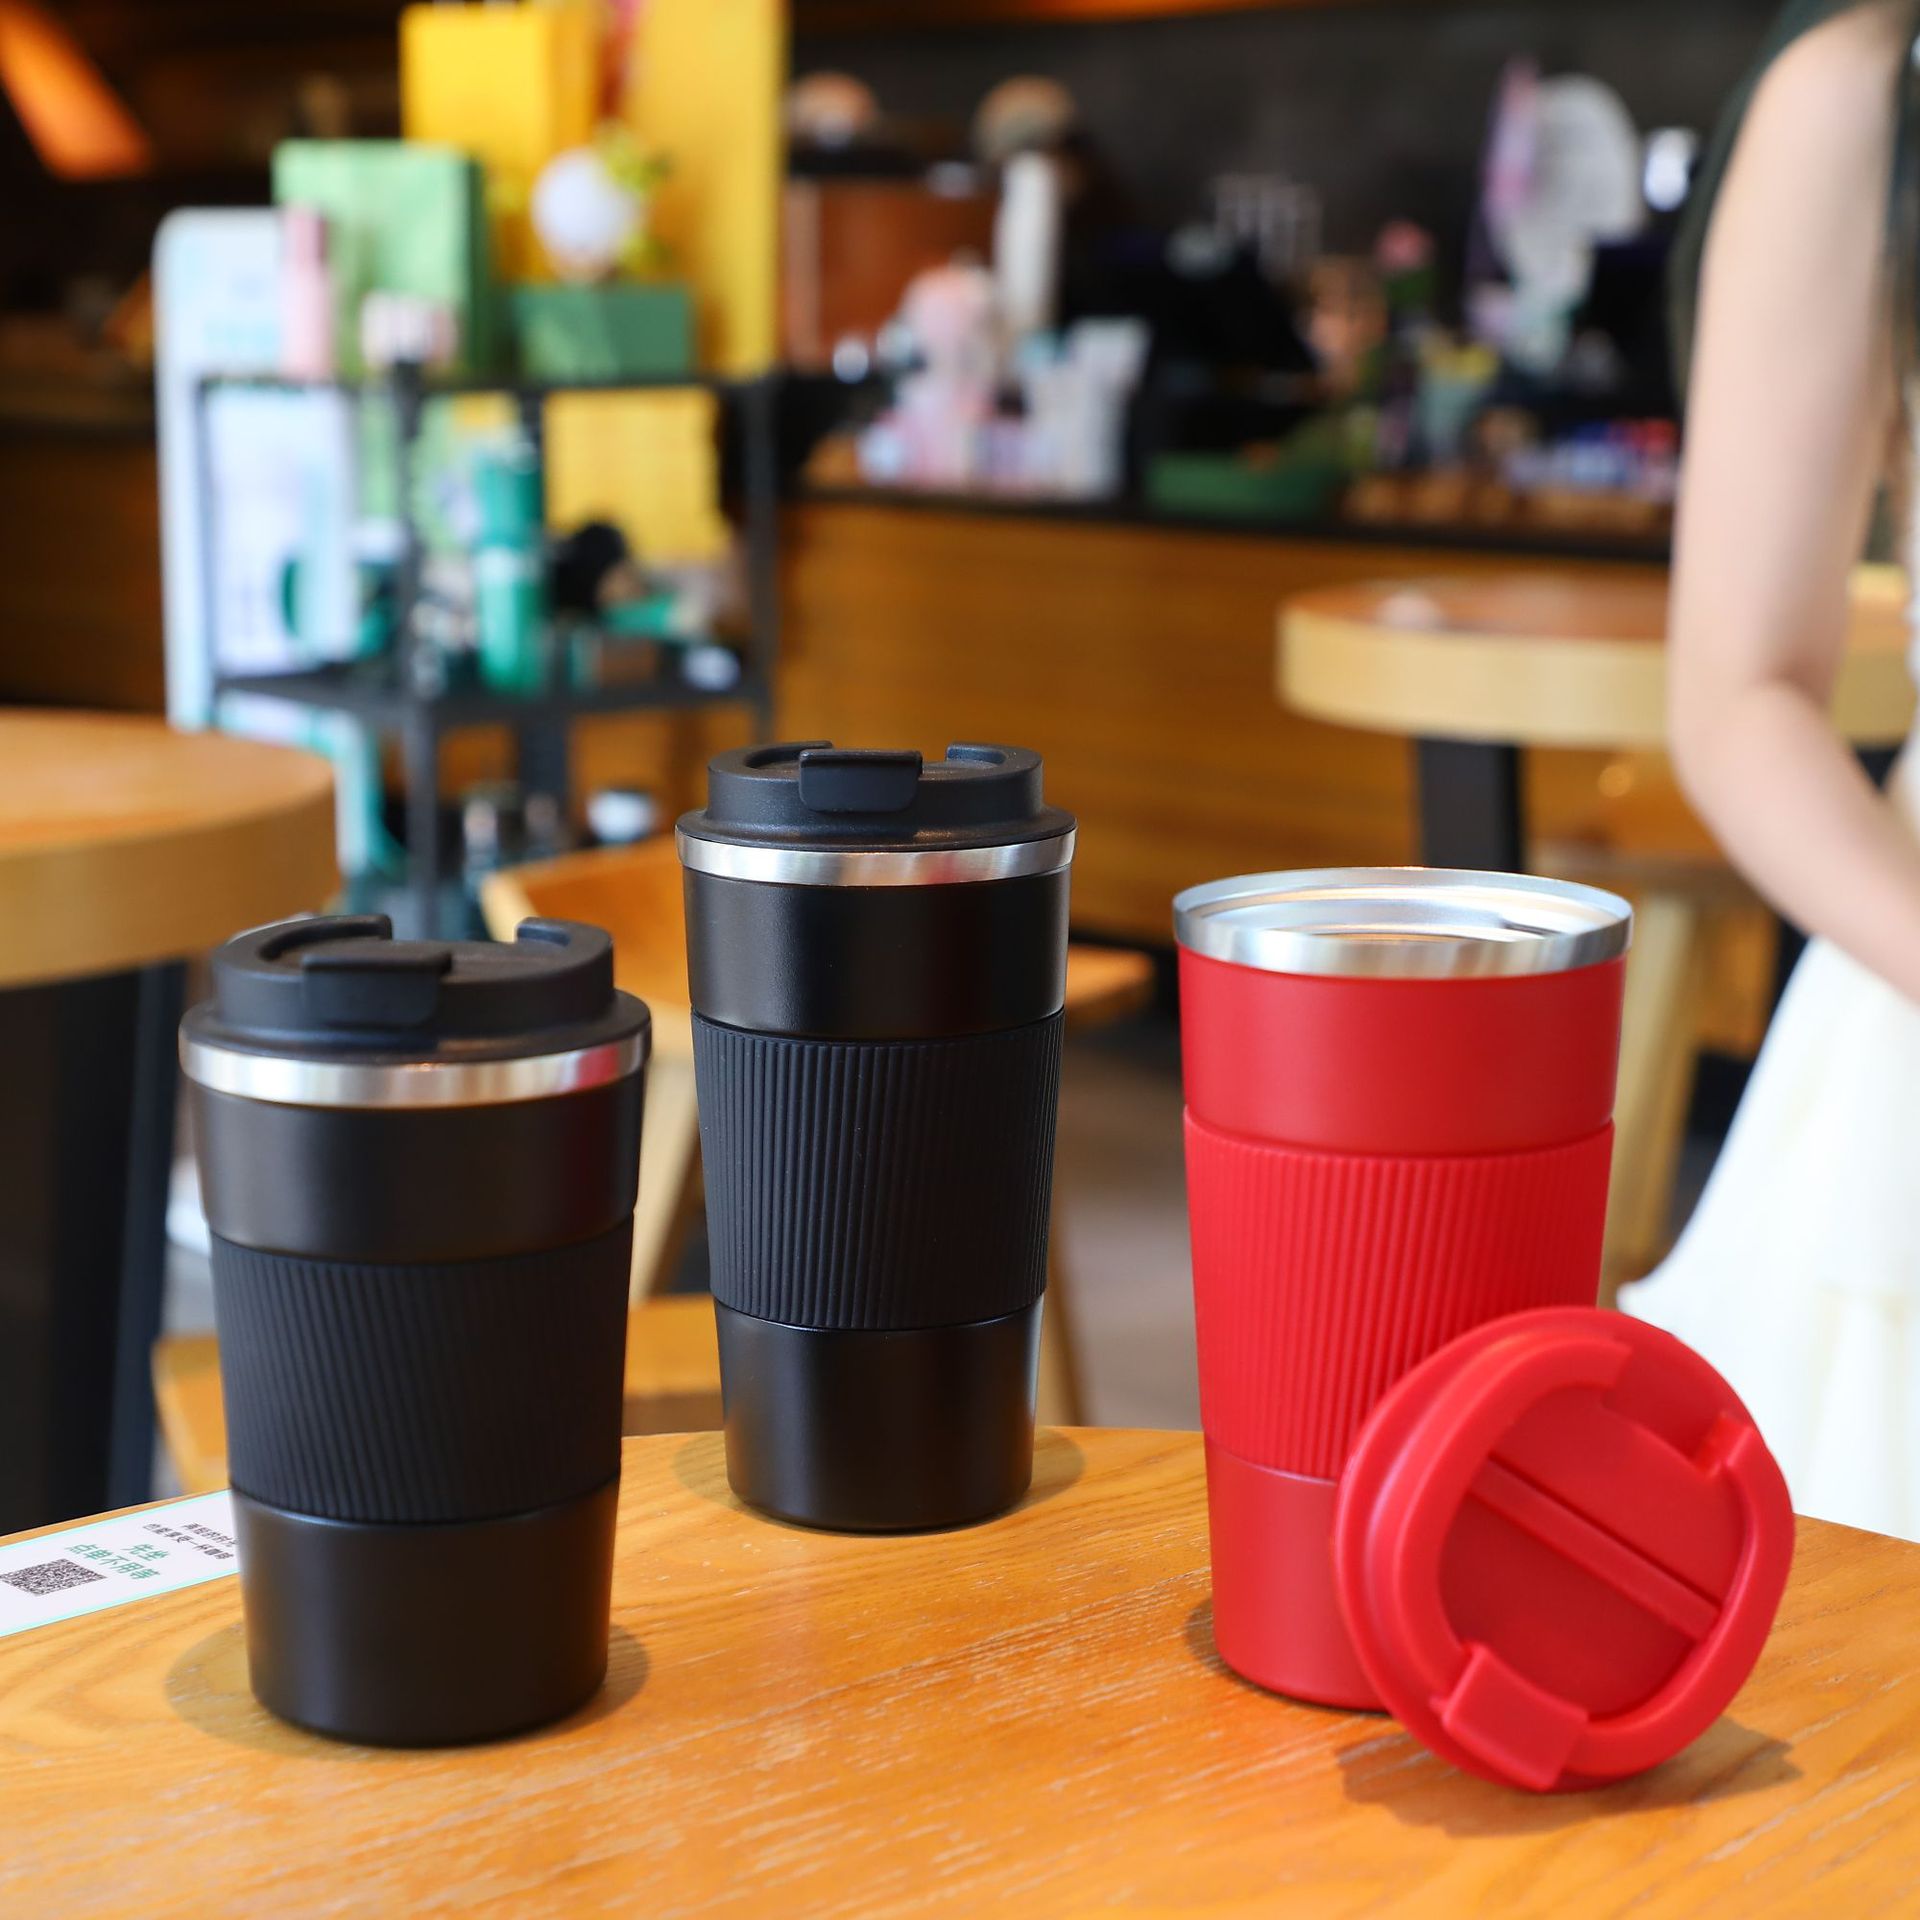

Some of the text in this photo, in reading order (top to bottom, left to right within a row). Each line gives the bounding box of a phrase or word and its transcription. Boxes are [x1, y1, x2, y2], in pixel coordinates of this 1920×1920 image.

[65, 1544, 161, 1580] 点单不用等
[121, 1544, 170, 1561] 先坐
